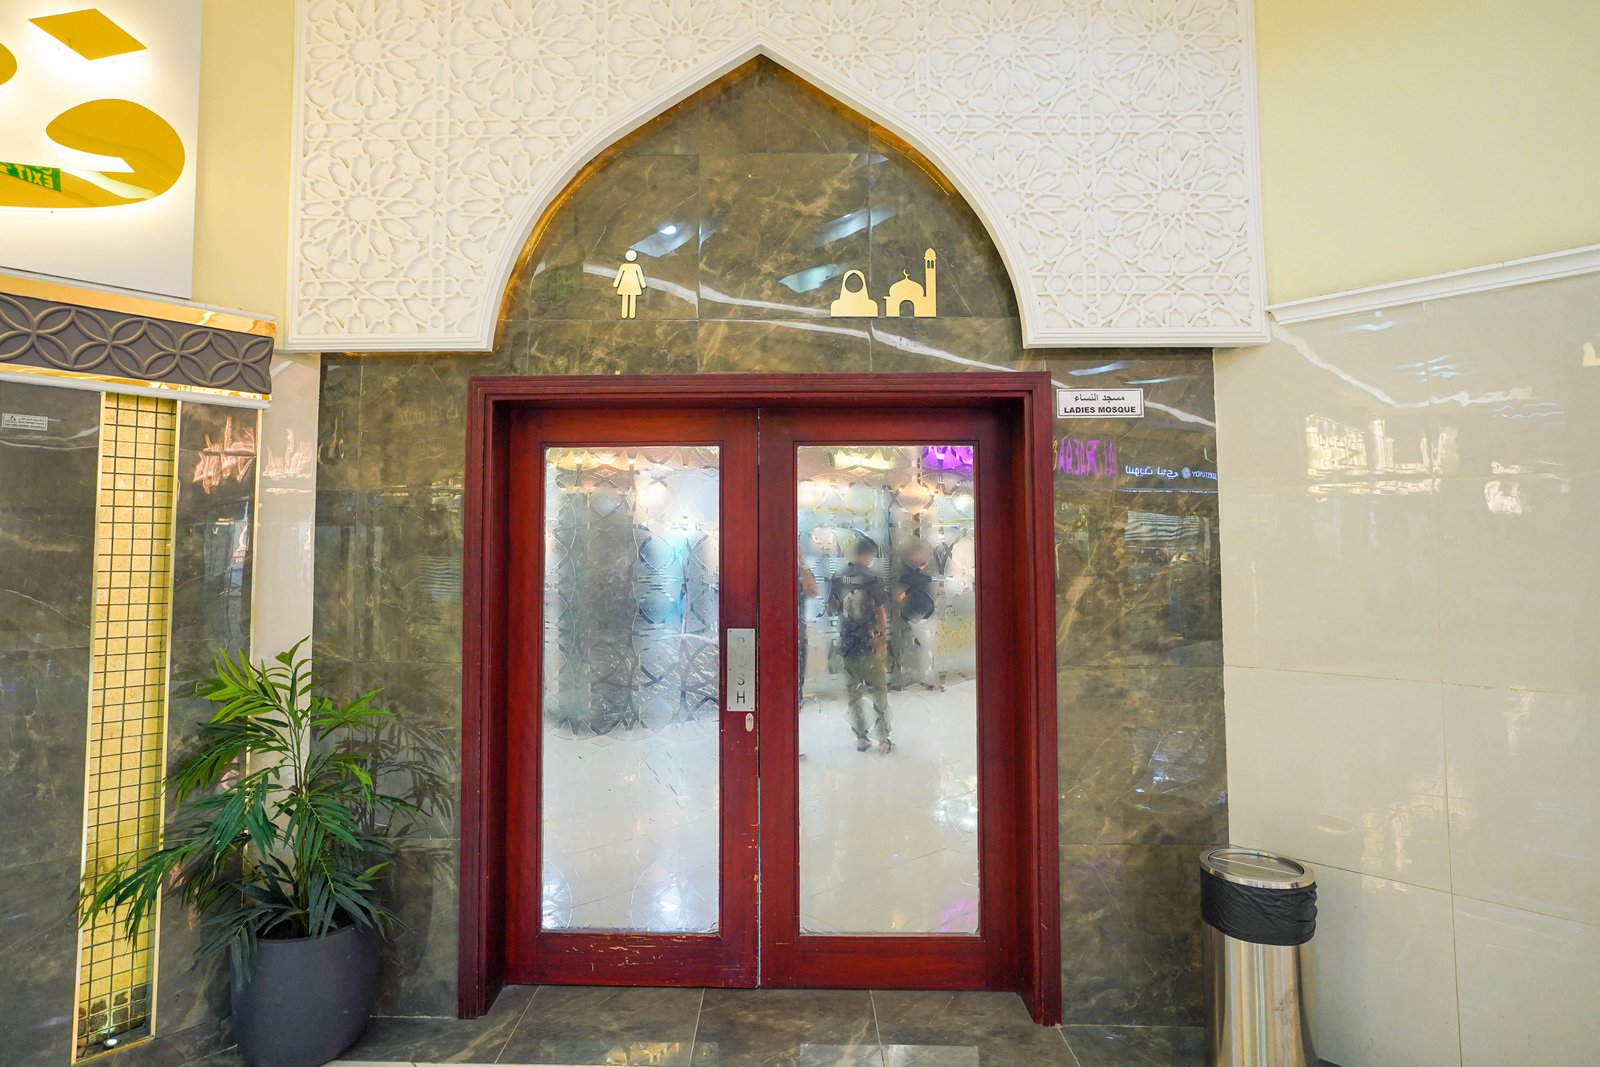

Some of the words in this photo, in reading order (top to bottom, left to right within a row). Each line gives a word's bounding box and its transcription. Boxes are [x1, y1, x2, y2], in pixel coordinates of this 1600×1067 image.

[1075, 393, 1098, 402] النساء
[1102, 394, 1125, 404] مسجد
[1064, 406, 1095, 414] LADIES
[1098, 406, 1136, 414] MOSQUE
